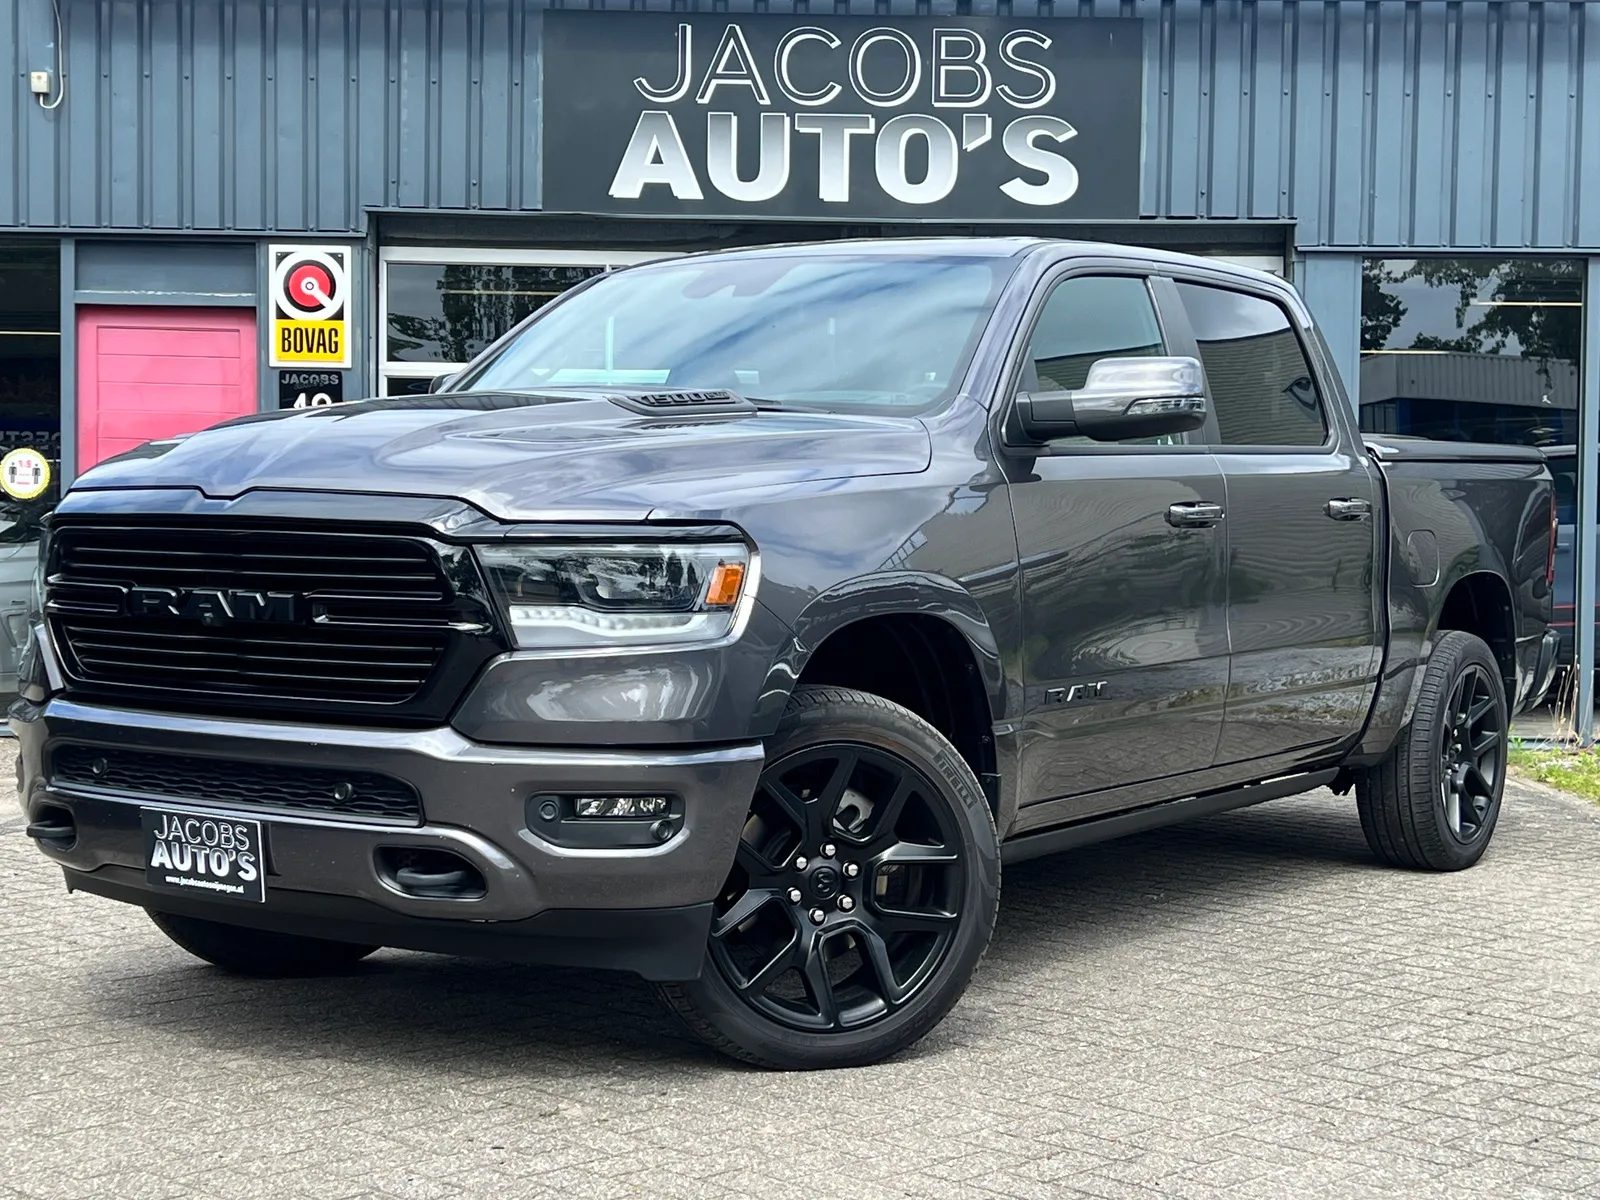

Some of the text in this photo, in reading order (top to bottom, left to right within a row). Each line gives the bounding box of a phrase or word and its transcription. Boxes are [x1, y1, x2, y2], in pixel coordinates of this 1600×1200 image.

[633, 23, 1057, 109] JACOBS
[608, 110, 1079, 206] AUTO'S
[281, 326, 339, 354] BOVAG
[281, 373, 339, 385] JACOBS
[131, 586, 296, 622] RAM
[933, 749, 976, 810] PIRELLI
[153, 814, 249, 850] JACOBS
[150, 839, 258, 882] AUTO'S
